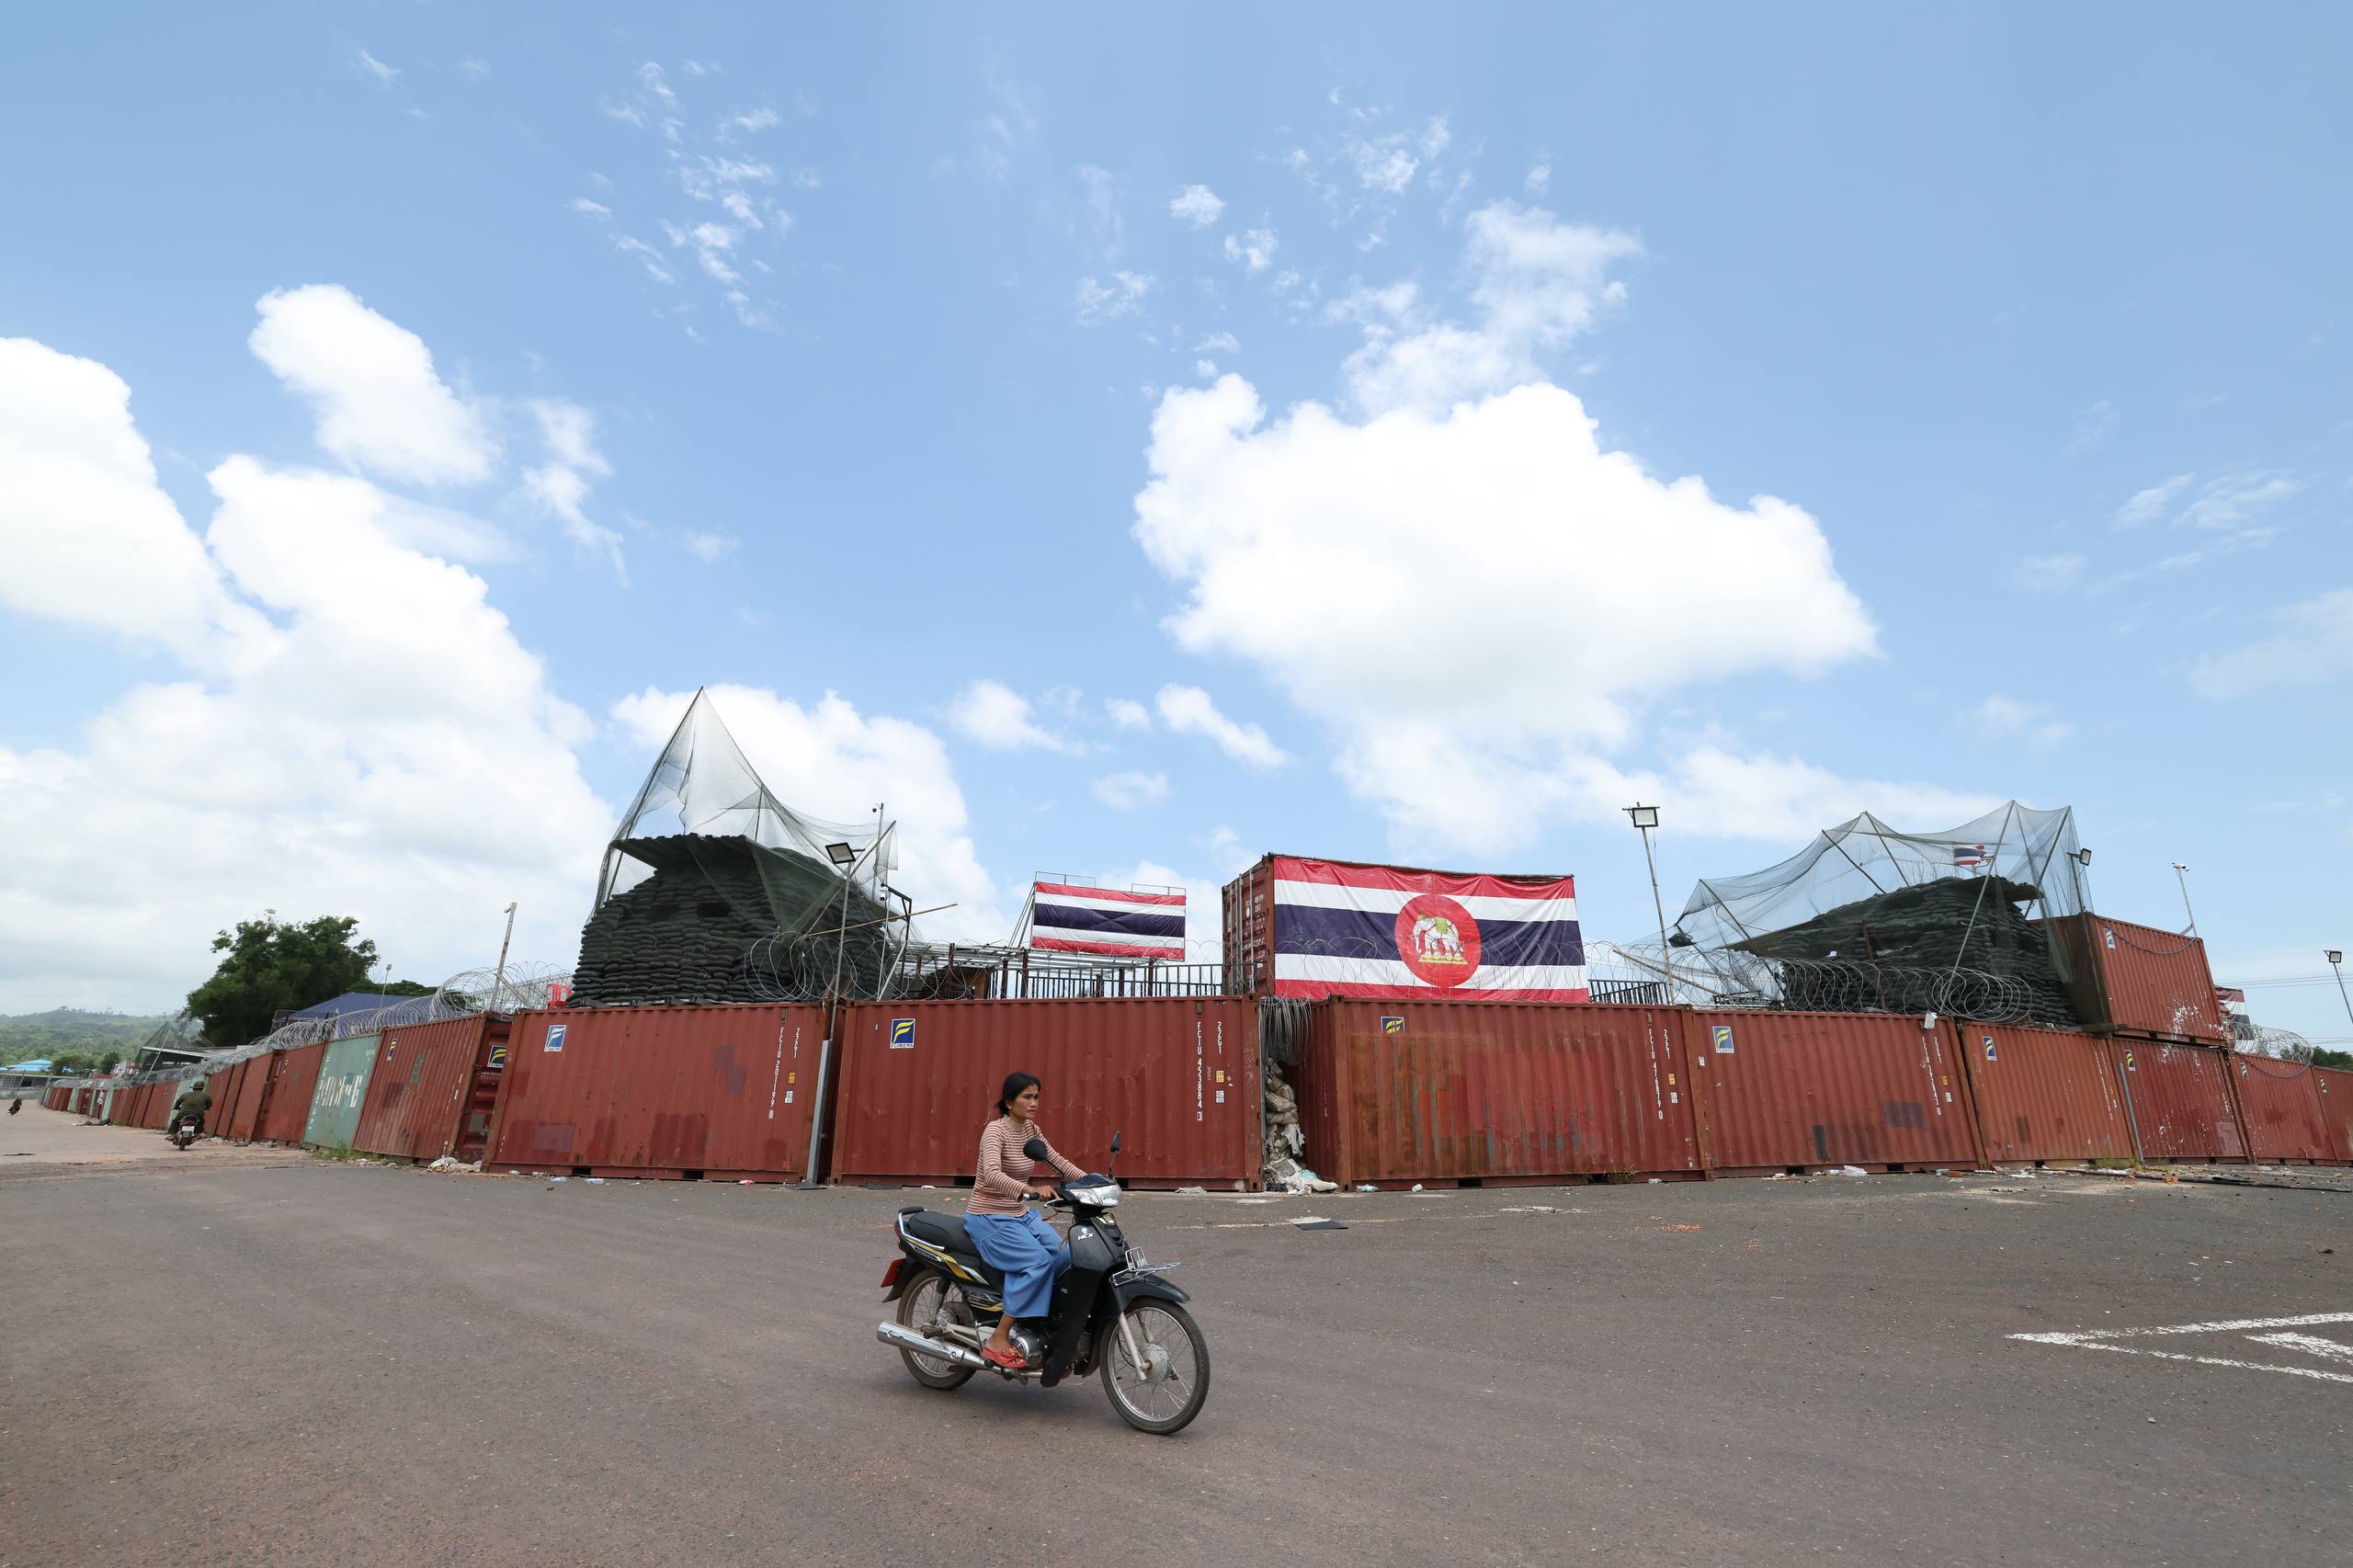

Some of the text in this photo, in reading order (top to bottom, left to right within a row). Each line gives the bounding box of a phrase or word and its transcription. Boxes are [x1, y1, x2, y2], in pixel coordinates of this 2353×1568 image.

[777, 1027, 785, 1058] FCIU
[771, 1060, 780, 1108] 201199
[1654, 1061, 1662, 1108] 476879
[1197, 1111, 1203, 1121] 3
[1077, 1233, 1094, 1241] NCX
